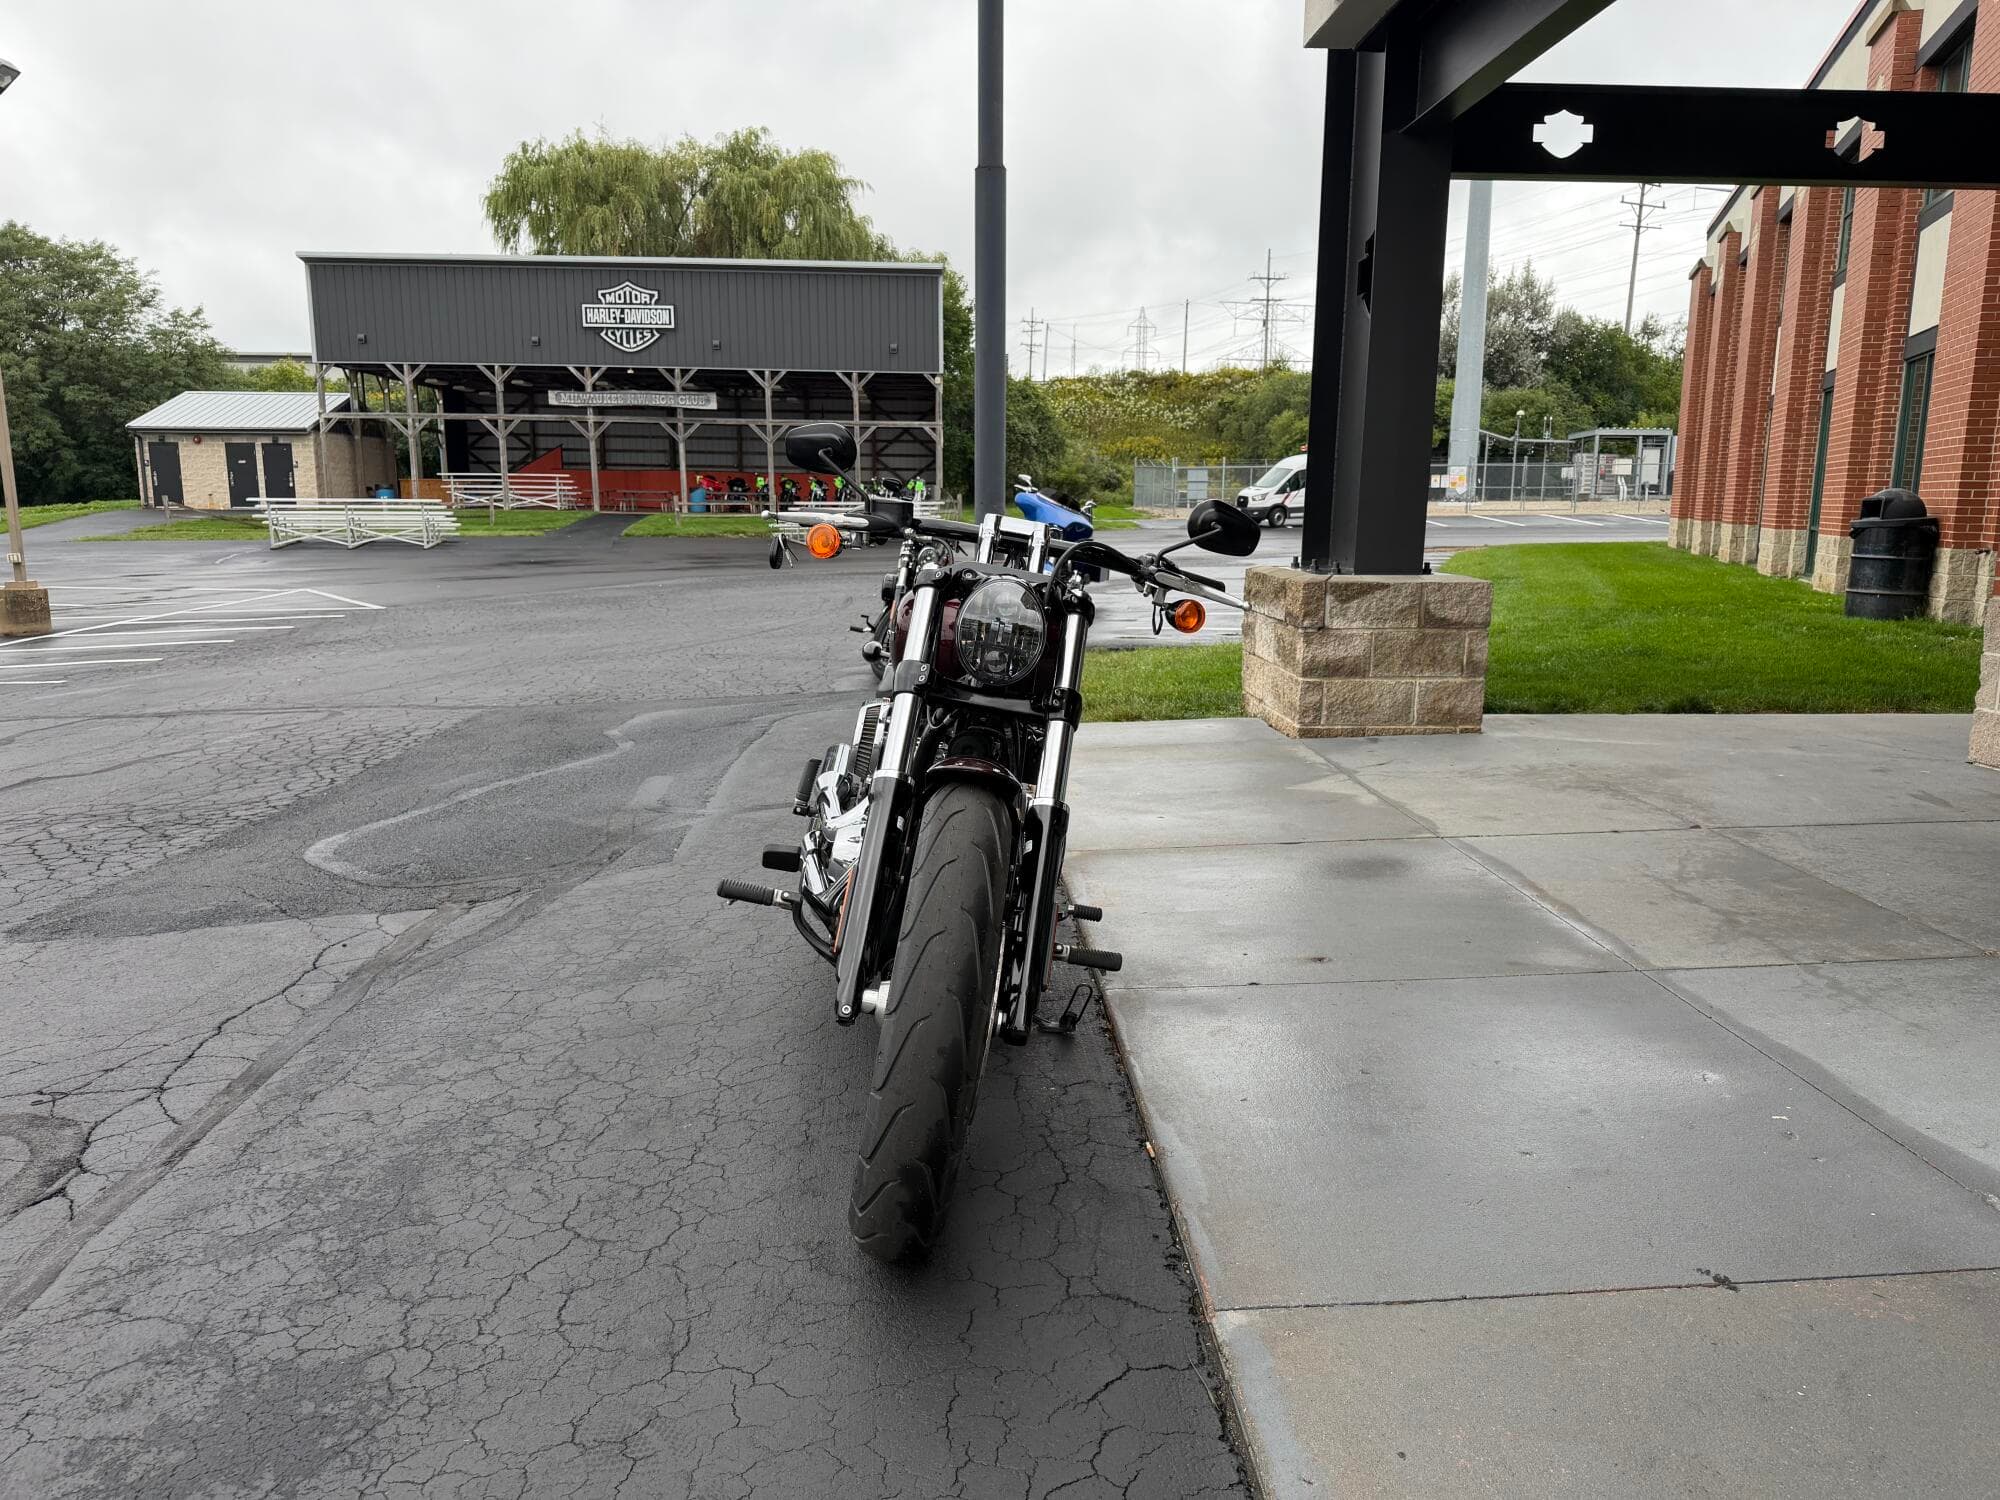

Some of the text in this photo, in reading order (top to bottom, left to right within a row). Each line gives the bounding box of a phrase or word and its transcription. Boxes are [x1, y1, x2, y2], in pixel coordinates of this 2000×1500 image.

[605, 286, 650, 304] MOTOR
[586, 307, 670, 325] HARLEY-DAVIDSON
[607, 329, 652, 348] CYCLES
[560, 393, 624, 404] MILWAUKEE
